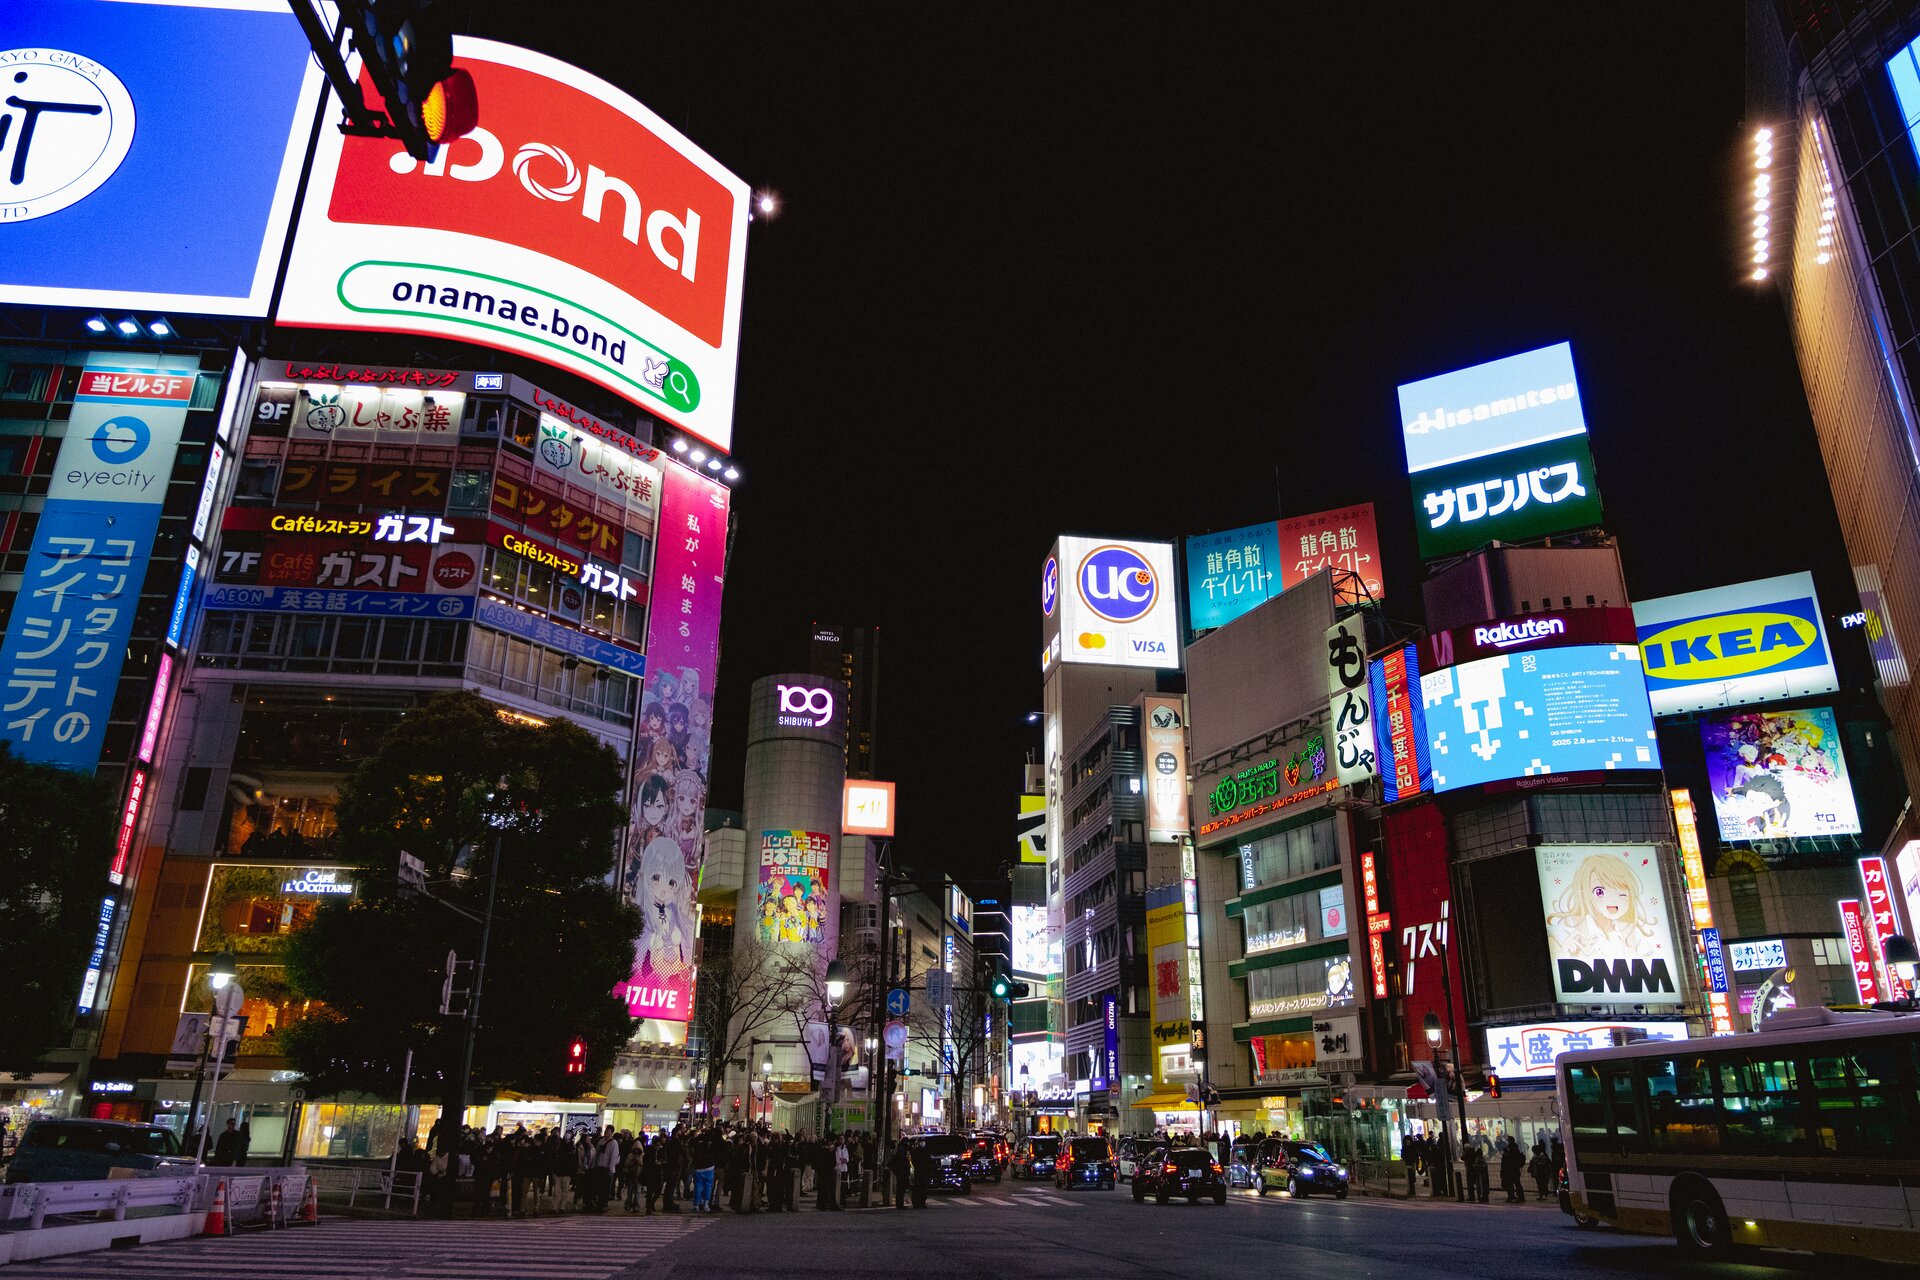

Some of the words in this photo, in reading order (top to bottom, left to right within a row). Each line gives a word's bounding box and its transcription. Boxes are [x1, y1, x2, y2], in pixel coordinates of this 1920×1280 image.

[49, 52, 102, 79] GINZA
[392, 278, 627, 365] onamae.bond
[90, 374, 182, 396] 当ビル5F
[285, 363, 459, 387] しゃぶしゃぶバイキング
[477, 376, 502, 388] 寿司
[258, 402, 291, 421] 9F
[353, 402, 451, 432] しゃぶ葉
[1406, 383, 1575, 434] Hisamitsu
[534, 388, 660, 461] しゃぶしゃぶバイキング
[67, 469, 155, 491] eyecity
[285, 465, 441, 498] プライス
[579, 447, 653, 502] しゃぶ葉
[1423, 461, 1586, 529] サロンパス
[374, 514, 455, 544] ガスト
[495, 479, 618, 551] コンタクト
[1300, 526, 1358, 558] 龍角散
[221, 551, 262, 573] 7F
[316, 551, 418, 588] ガスト
[438, 567, 471, 579] ガスト
[1206, 543, 1261, 575] 龍角散
[580, 561, 638, 600] ガスト
[677, 513, 701, 653] 私が、始まる。
[1200, 567, 1273, 599] ダイレクト
[213, 588, 264, 604] AEON
[281, 590, 430, 613] 英会話イーオン
[440, 599, 465, 613] 6F
[486, 605, 526, 631] AEON
[1475, 618, 1564, 647] Rakuten
[1841, 612, 1866, 628] PAR
[3, 536, 95, 742] アイシティ
[53, 539, 136, 743] コンタクトの
[535, 620, 643, 671] 英会話イーオン
[1132, 640, 1166, 654] VISA
[1644, 621, 1806, 670] IKEA
[777, 685, 834, 727] 109
[1328, 625, 1375, 774] もんじゃ
[778, 716, 813, 727] SHIBUYA
[1383, 656, 1413, 790] 三千里薬品
[1552, 738, 1572, 746] 2025
[1239, 769, 1278, 805] 西村
[1516, 778, 1545, 789] Rakuten
[1545, 775, 1569, 785] Vision
[762, 834, 829, 851] パンダドラゴン
[761, 848, 828, 869] 日本武道館
[285, 880, 353, 894] L'OCCITANE
[305, 871, 336, 883] CAFÉ
[1844, 911, 1856, 929] BIG
[1852, 929, 1863, 954] ECHO
[1706, 931, 1726, 991] 大盛堂商事ビル
[1734, 955, 1784, 969] クリニック
[1744, 943, 1783, 955] れいわ
[1557, 958, 1676, 993] DMM
[625, 985, 678, 1009] 17LIVE
[92, 1082, 107, 1091] De
[108, 1083, 133, 1092] Salita
